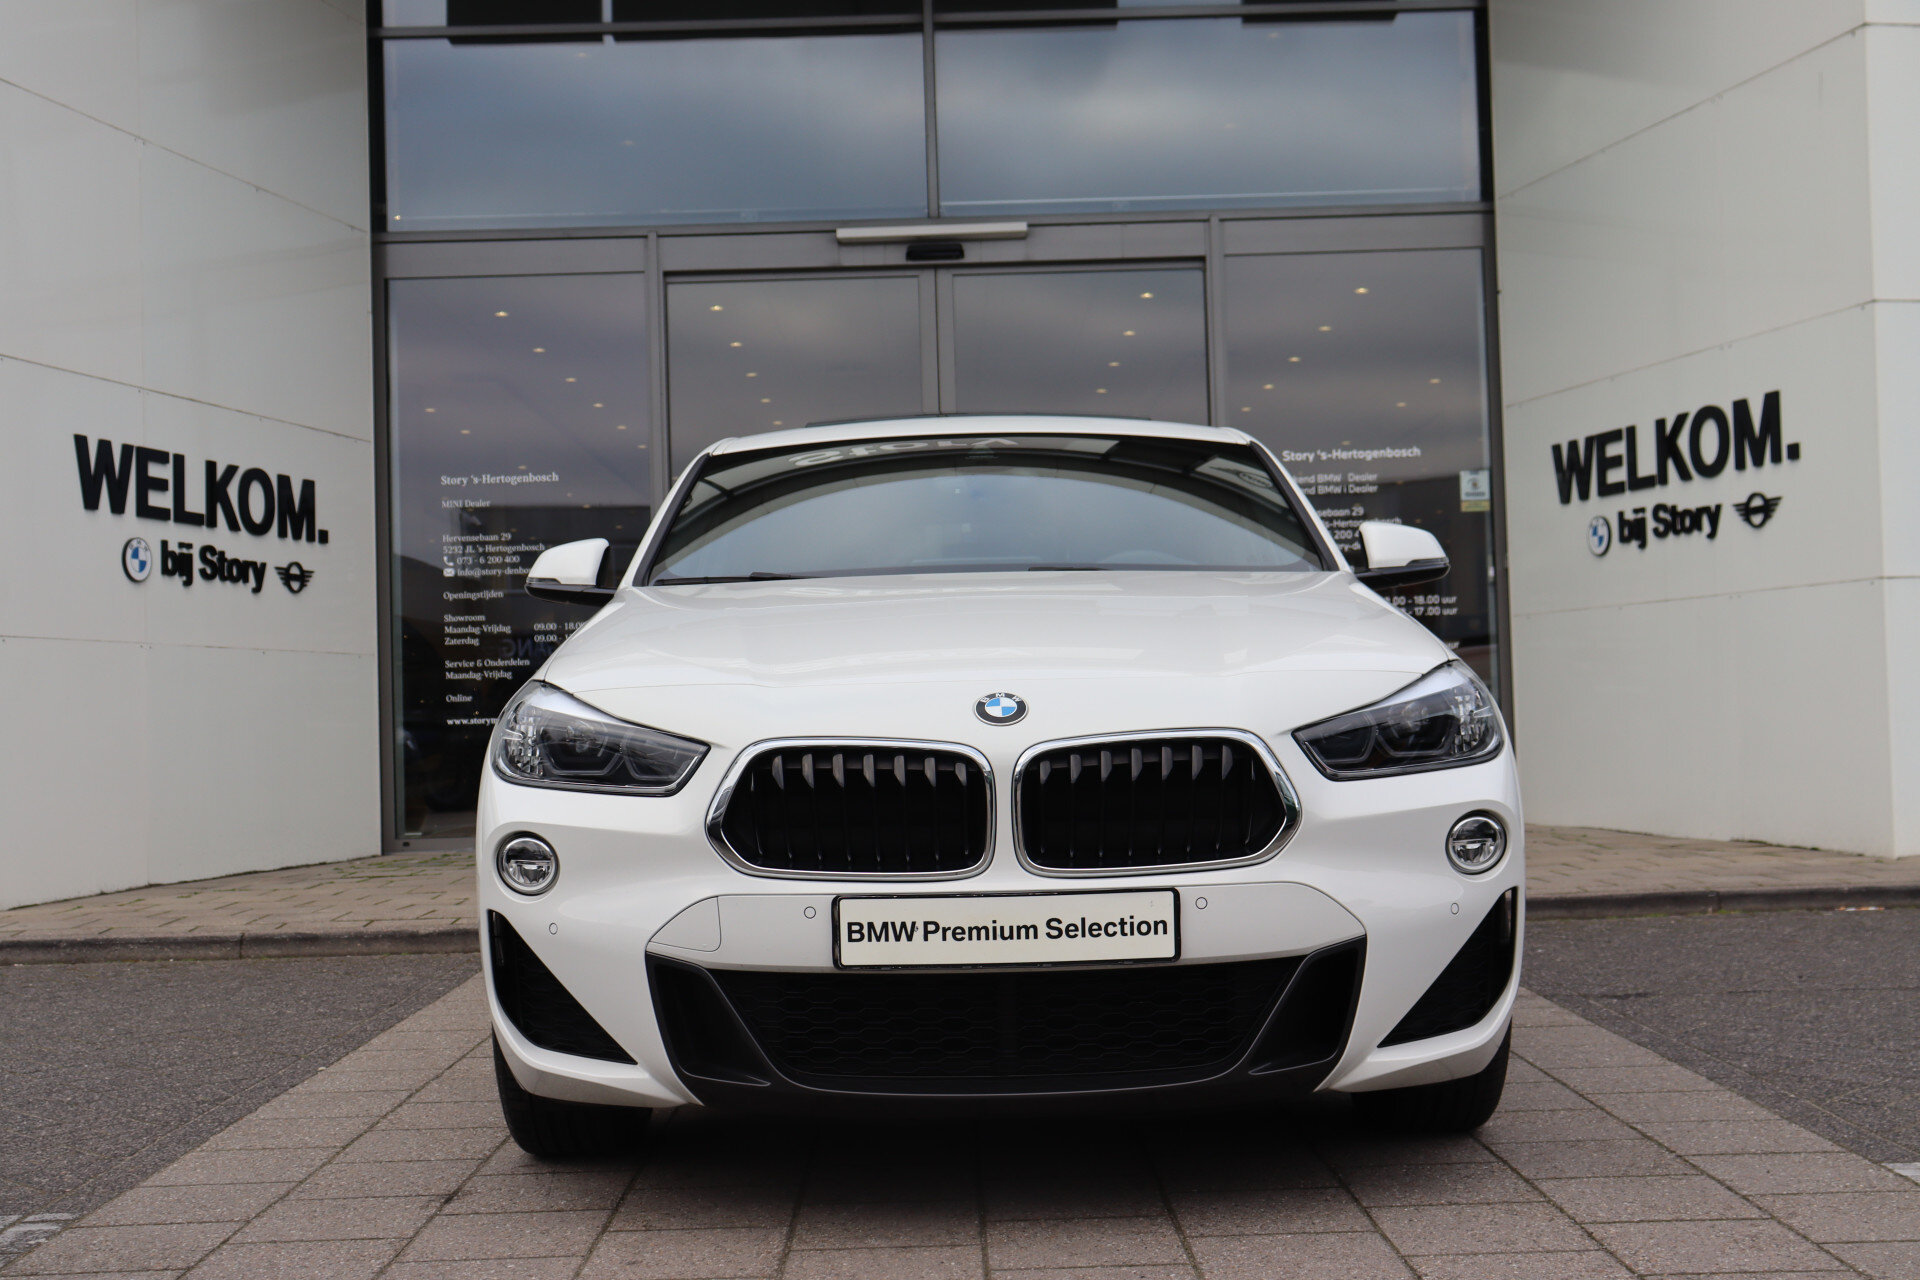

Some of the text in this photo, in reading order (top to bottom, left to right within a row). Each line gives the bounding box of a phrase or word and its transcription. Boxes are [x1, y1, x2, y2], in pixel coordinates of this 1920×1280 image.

[1552, 390, 1800, 504] WELKOM.
[1282, 449, 1315, 463] Story
[441, 475, 469, 488] Story
[1317, 474, 1342, 483] BMW
[1348, 472, 1378, 482] Dealer
[73, 433, 329, 544] WELKOM.
[1317, 485, 1343, 494] BMW
[1348, 483, 1379, 494] Dealer
[442, 499, 491, 508] MINI Dealer
[1351, 505, 1365, 516] 29
[1652, 503, 1722, 540] Story
[442, 532, 512, 543] Hervensebaan 29
[1334, 531, 1353, 540] 200
[442, 545, 463, 554] 5232
[456, 556, 473, 565] 073
[479, 555, 485, 564] 6
[486, 555, 503, 564] 200
[504, 554, 521, 563] 400
[199, 545, 267, 594] Story
[443, 589, 504, 601] Openingstijden
[1413, 594, 1440, 605] 18.00
[1441, 596, 1458, 604] uur
[1441, 607, 1459, 615] uur
[444, 614, 486, 622] Showroom
[444, 624, 512, 635] Maandag-Vrijdag
[533, 622, 557, 631] 09.00
[444, 636, 480, 647] Zaterdag
[533, 634, 557, 643] 09.00
[445, 658, 530, 669] Service & Onderdelen
[445, 670, 512, 681] Maandag-Vrijdag
[446, 694, 473, 703] Online
[847, 915, 1168, 943] BMW Premium Selection
